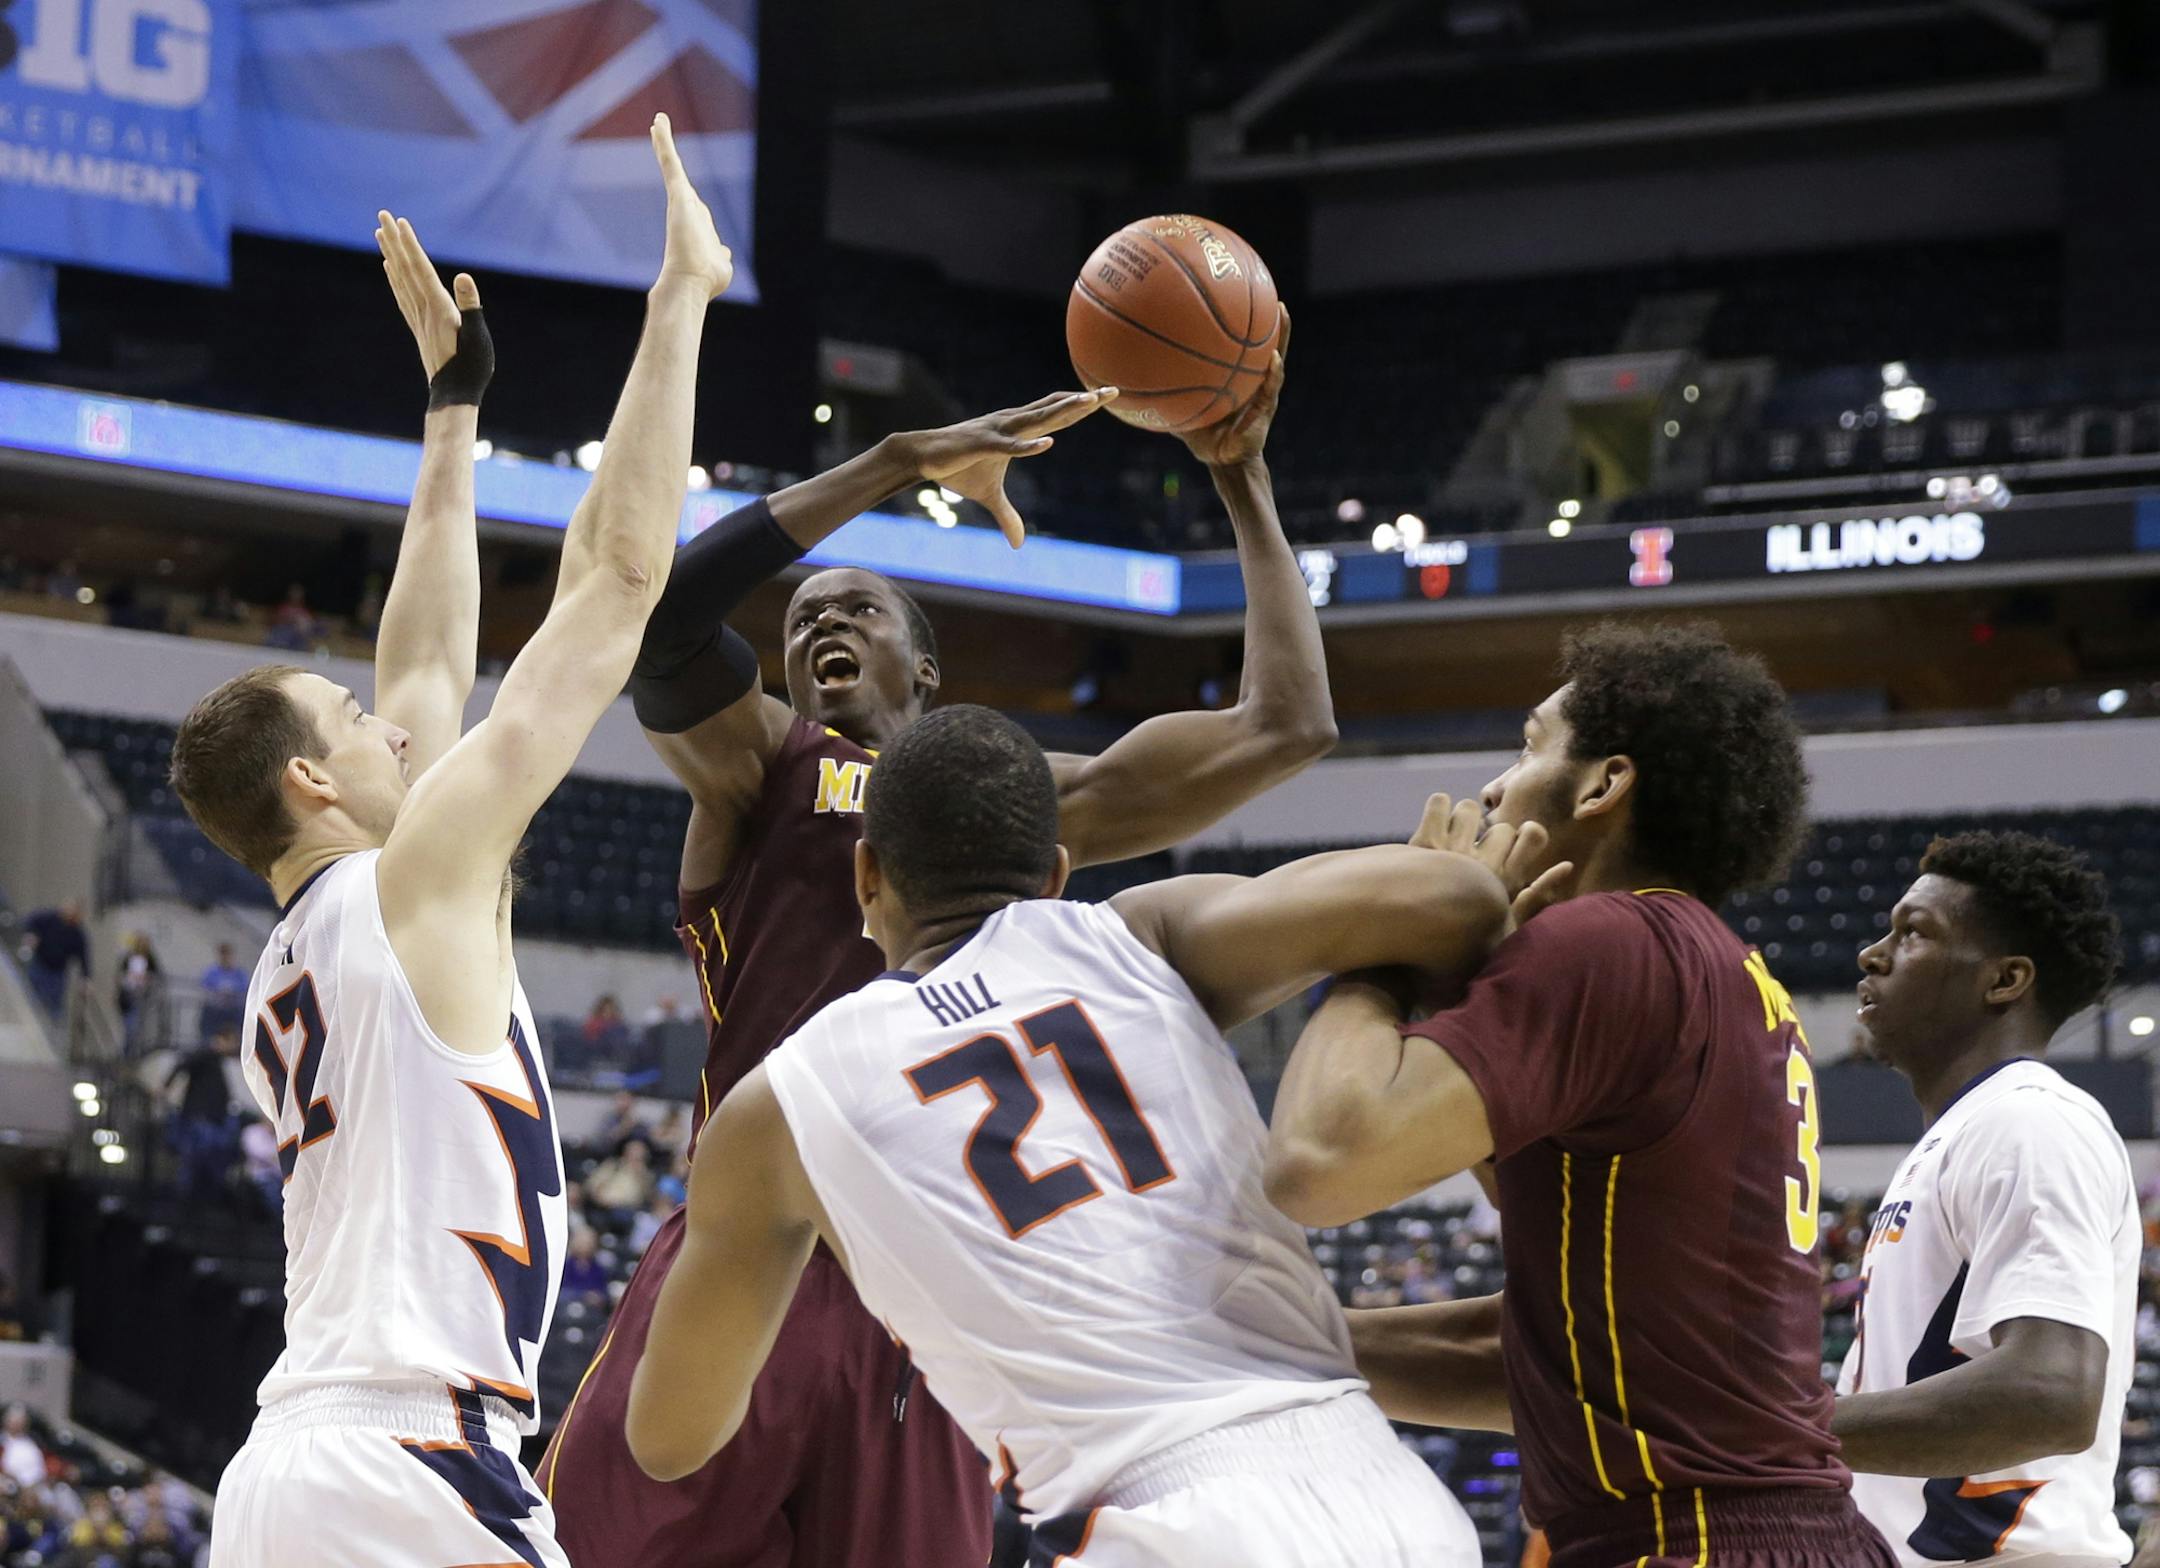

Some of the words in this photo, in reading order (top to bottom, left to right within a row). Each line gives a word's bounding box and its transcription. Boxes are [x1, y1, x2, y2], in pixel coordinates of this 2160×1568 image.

[1766, 511, 1985, 573] ILLINOIS
[916, 971, 1002, 1028] HILL
[902, 998, 1177, 1240] 21
